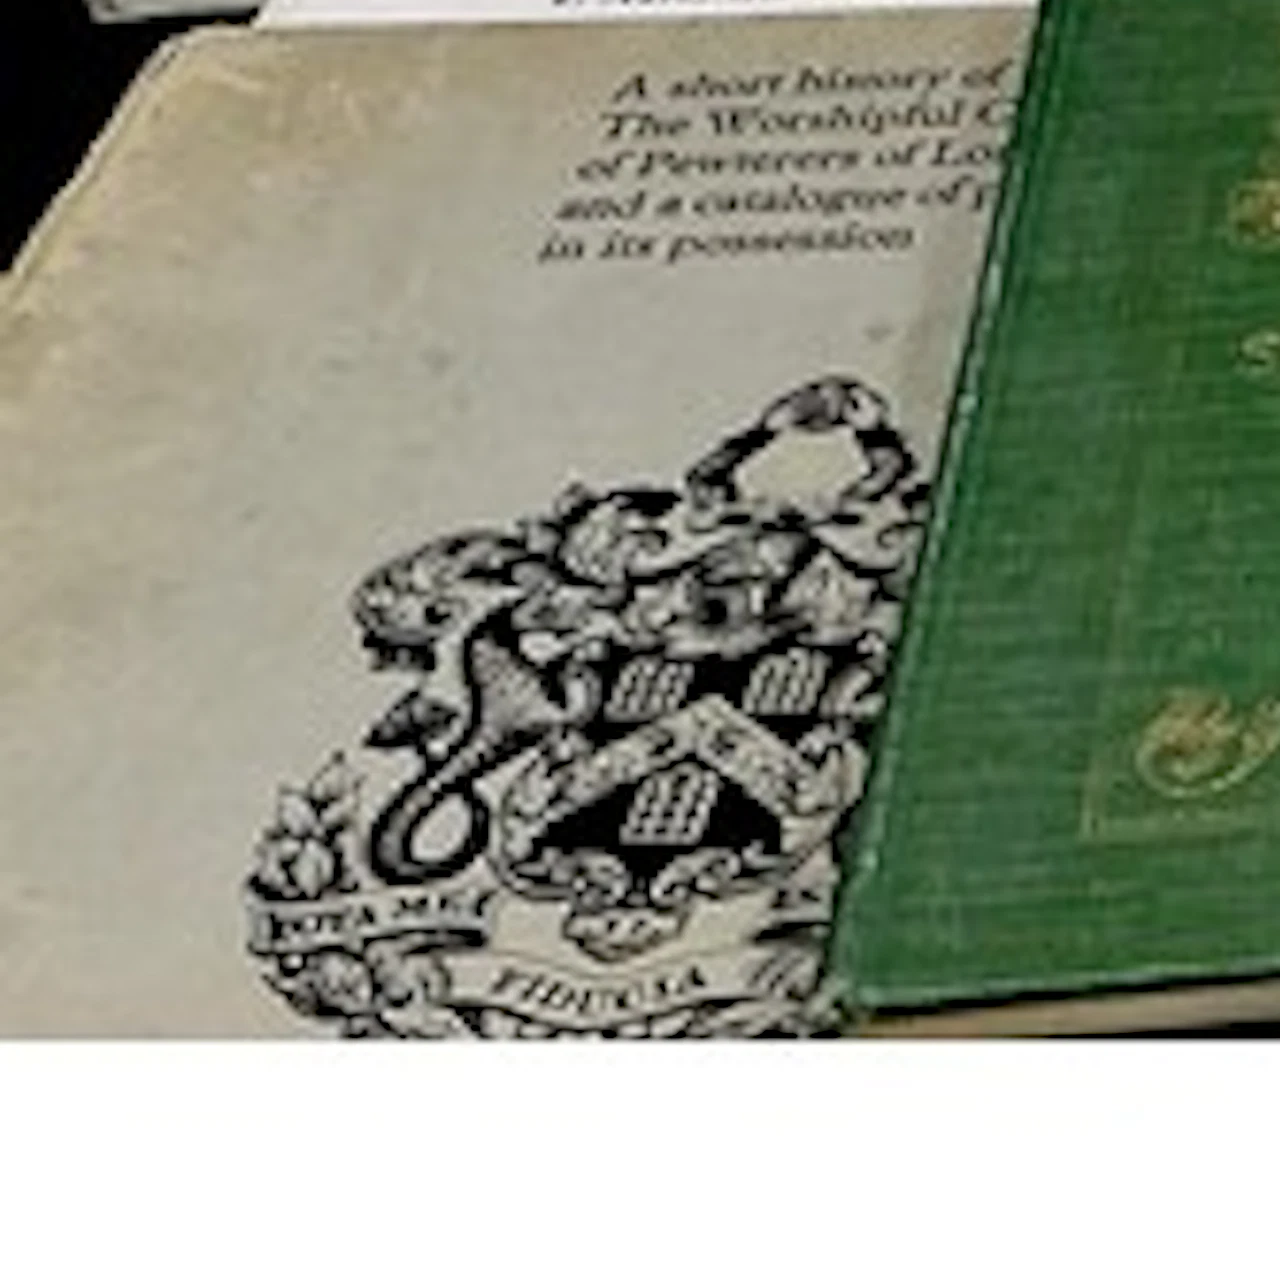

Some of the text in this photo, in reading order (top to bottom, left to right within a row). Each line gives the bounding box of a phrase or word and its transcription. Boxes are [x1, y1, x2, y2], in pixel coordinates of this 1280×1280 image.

[610, 57, 1014, 104] A short history of
[599, 110, 692, 140] The
[705, 99, 966, 137] Worshipful
[575, 148, 629, 184] of
[635, 146, 862, 181] Pewterers
[873, 141, 921, 170] of
[553, 192, 645, 222] and
[651, 196, 686, 217] a
[690, 184, 905, 221] catalogue
[914, 179, 968, 209] of
[537, 226, 917, 267] in its possession
